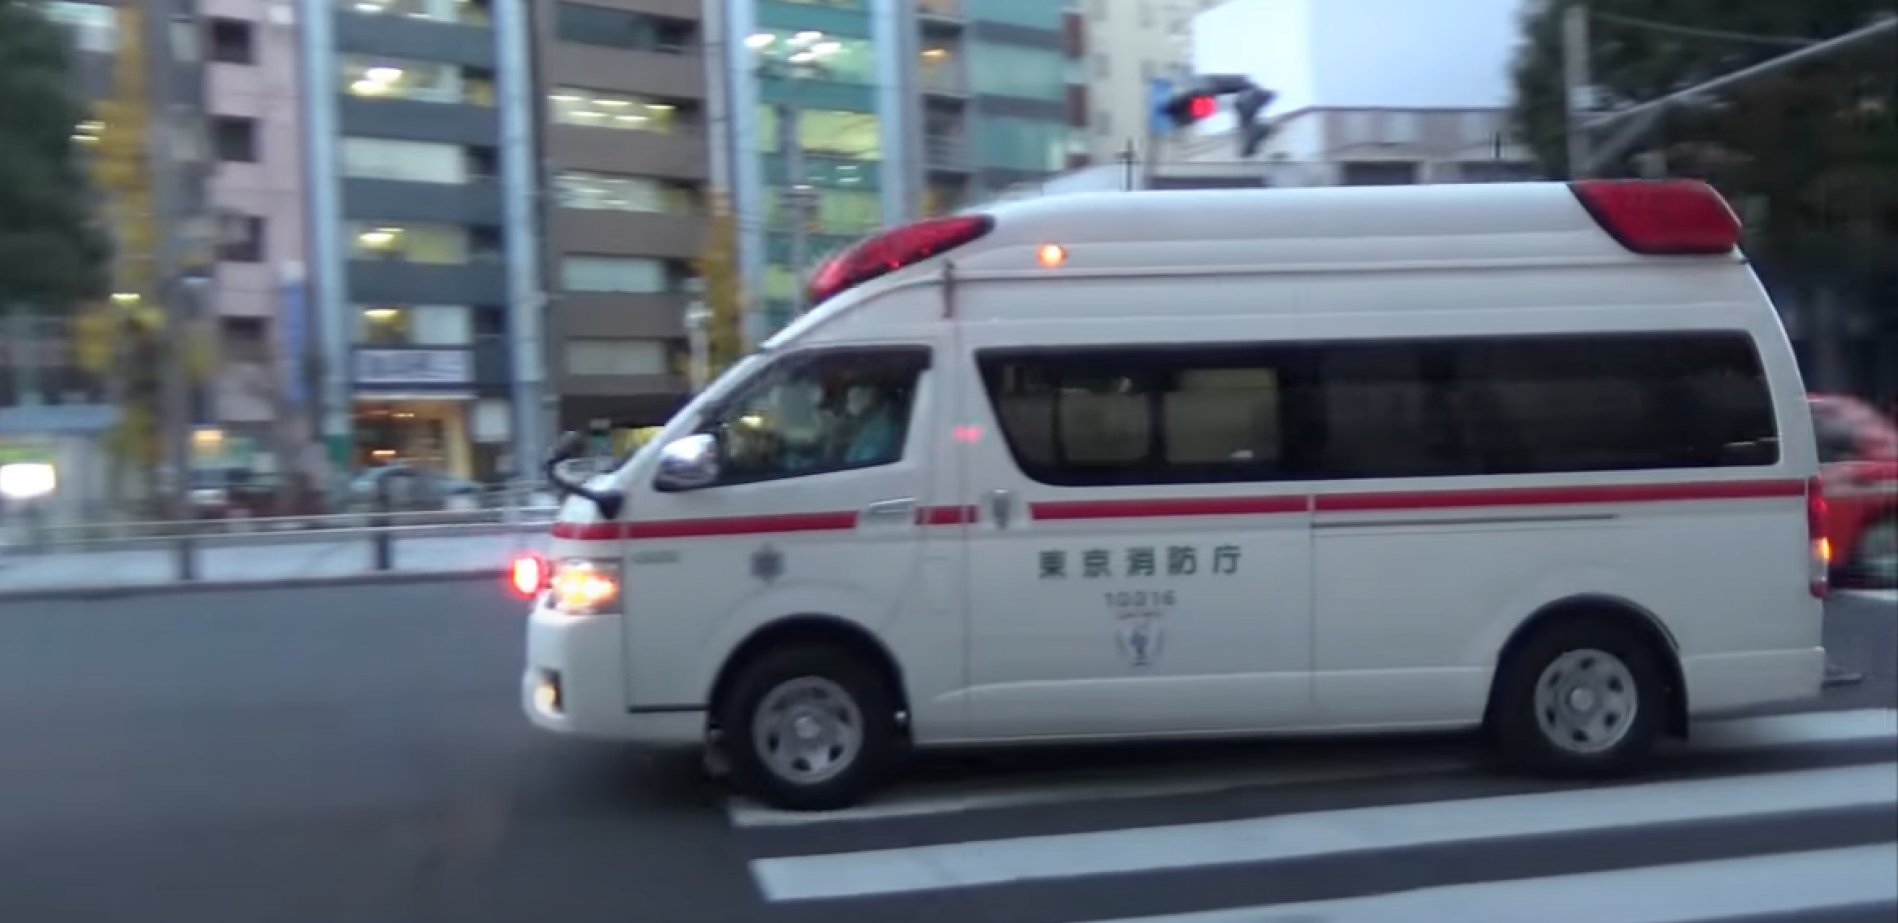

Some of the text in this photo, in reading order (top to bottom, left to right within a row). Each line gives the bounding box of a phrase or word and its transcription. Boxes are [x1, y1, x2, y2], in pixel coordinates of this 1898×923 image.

[1038, 544, 1242, 579] 東京消防庁
